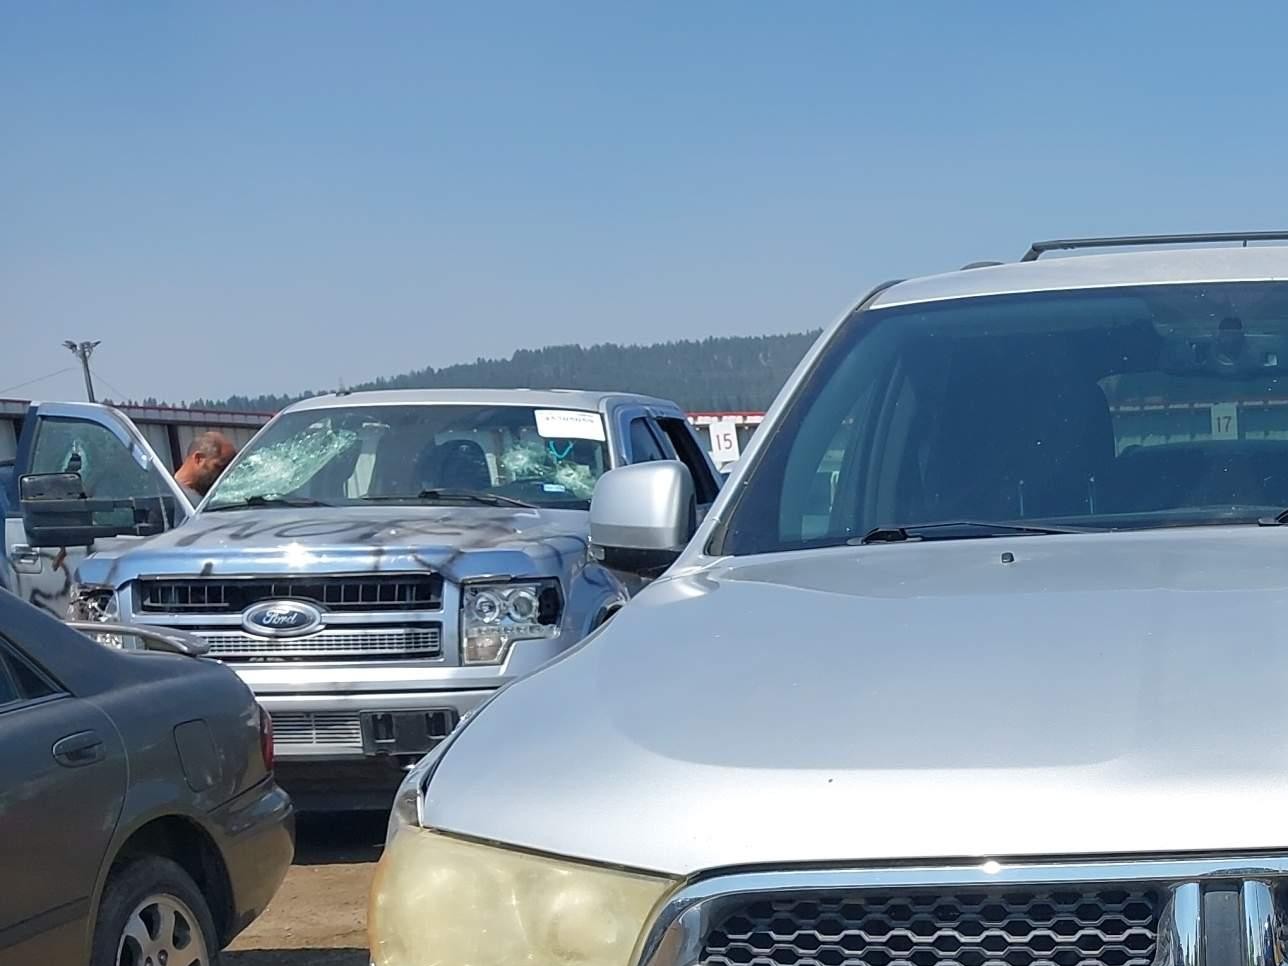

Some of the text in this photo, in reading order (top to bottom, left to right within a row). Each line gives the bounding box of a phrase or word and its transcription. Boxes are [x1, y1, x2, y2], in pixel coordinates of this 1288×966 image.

[1216, 415, 1232, 433] 17
[716, 432, 733, 451] 15
[262, 609, 298, 625] Ford
